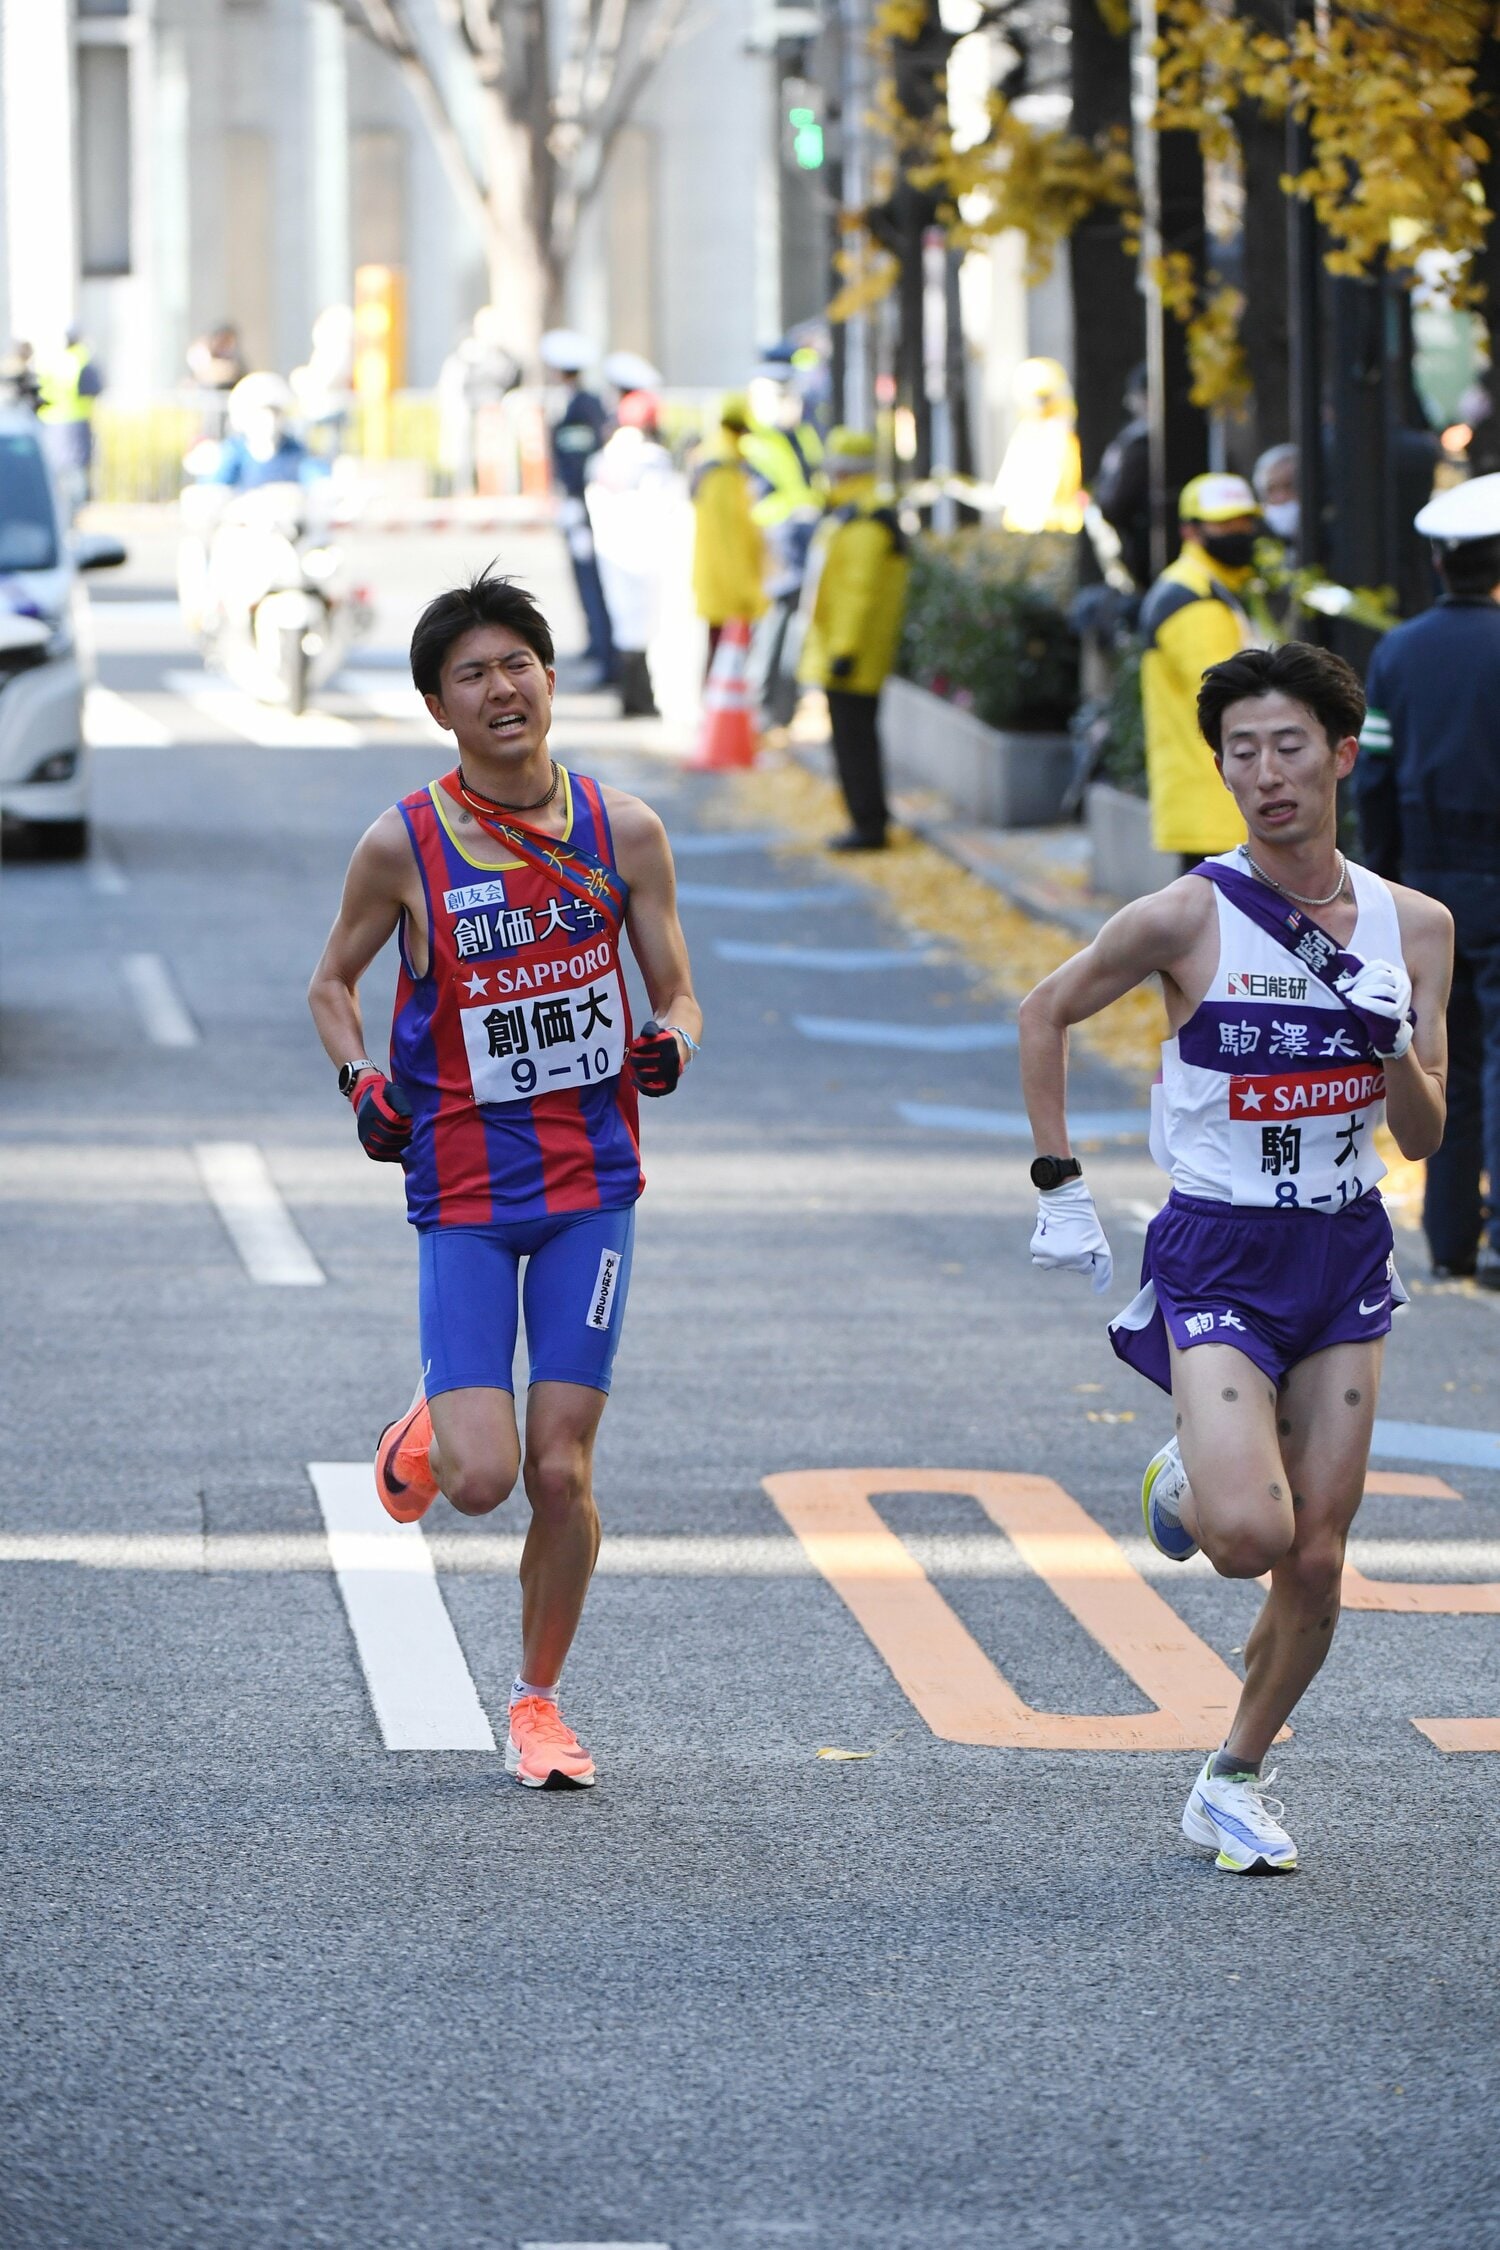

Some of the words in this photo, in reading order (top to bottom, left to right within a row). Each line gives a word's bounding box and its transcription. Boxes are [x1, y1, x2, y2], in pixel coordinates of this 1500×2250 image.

[446, 884, 503, 911] 創友会
[496, 942, 611, 993] SAPPORO
[1250, 975, 1308, 1001] 日能研
[482, 987, 613, 1059] 創価大
[1219, 1020, 1374, 1060] 駒澤大
[1184, 1309, 1247, 1339] 駒大
